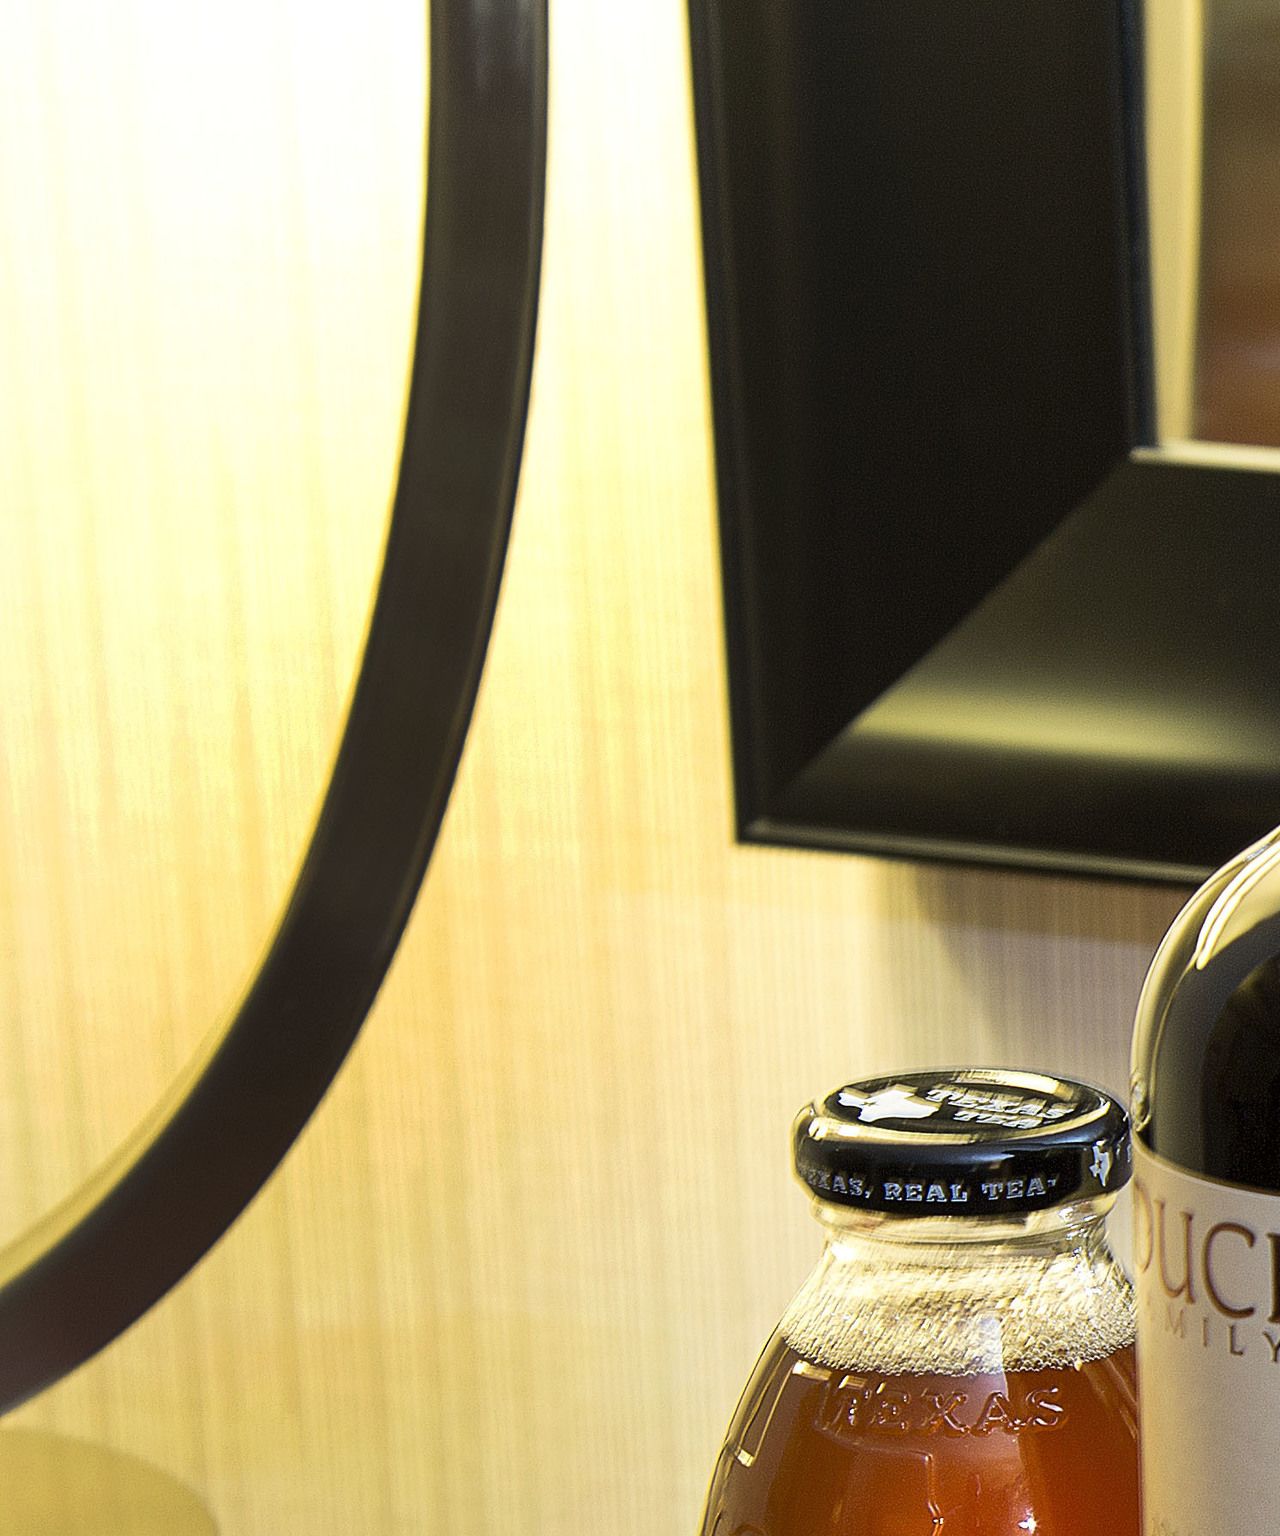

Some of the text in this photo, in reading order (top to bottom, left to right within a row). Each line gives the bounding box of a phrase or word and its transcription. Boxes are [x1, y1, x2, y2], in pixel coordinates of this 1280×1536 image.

[926, 1086, 1078, 1121] TEXAS
[952, 1109, 1043, 1130] TEA
[883, 1182, 968, 1203] REAL
